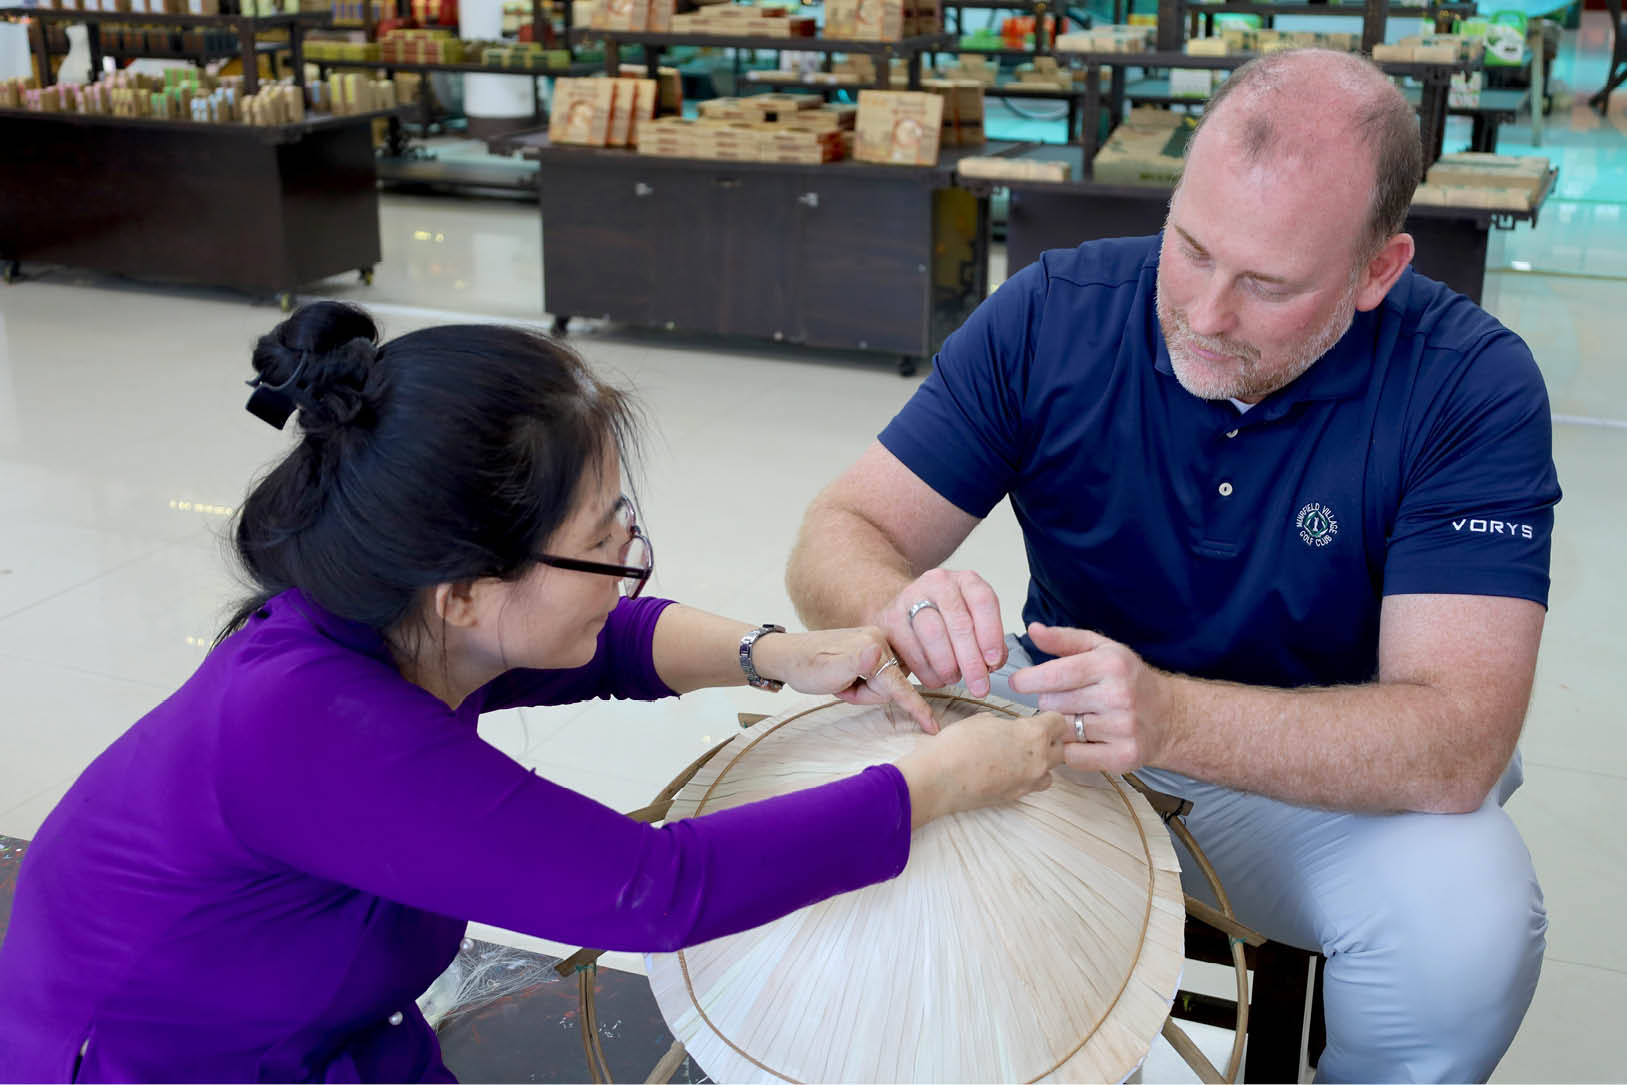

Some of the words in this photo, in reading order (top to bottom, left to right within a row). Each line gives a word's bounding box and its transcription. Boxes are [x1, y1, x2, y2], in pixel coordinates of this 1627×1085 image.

[1452, 518, 1534, 539] VORYS
[1299, 530, 1314, 546] GOLF
[1315, 534, 1333, 547] CLUB
